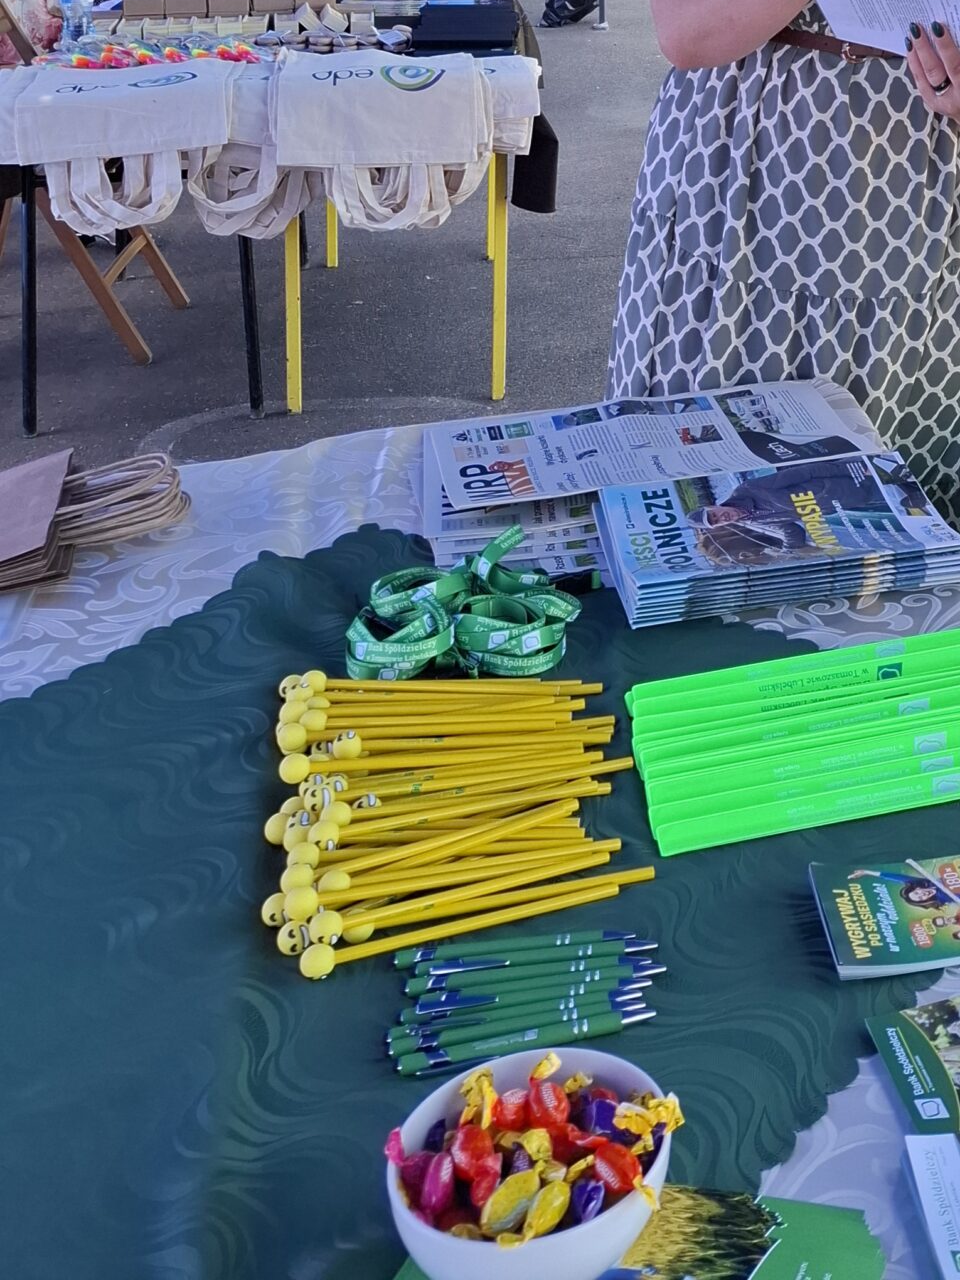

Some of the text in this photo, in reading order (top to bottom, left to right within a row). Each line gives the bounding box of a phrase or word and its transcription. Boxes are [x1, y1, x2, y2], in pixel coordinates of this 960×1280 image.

[459, 463, 514, 502] WRP
[368, 639, 438, 654] Bank Spółdzielczy
[484, 652, 554, 668] Bank Spółdzielczy
[758, 676, 805, 692] Lubelskim
[806, 669, 860, 685] Tomaszowie
[832, 889, 873, 959] WYGRYWAJ
[848, 883, 884, 947] PO SĄSIEDZKU
[877, 913, 897, 948] naszym
[886, 1027, 924, 1096] Bank Spółdzielczy
[925, 1150, 959, 1247] Bank Spółdzielczy
